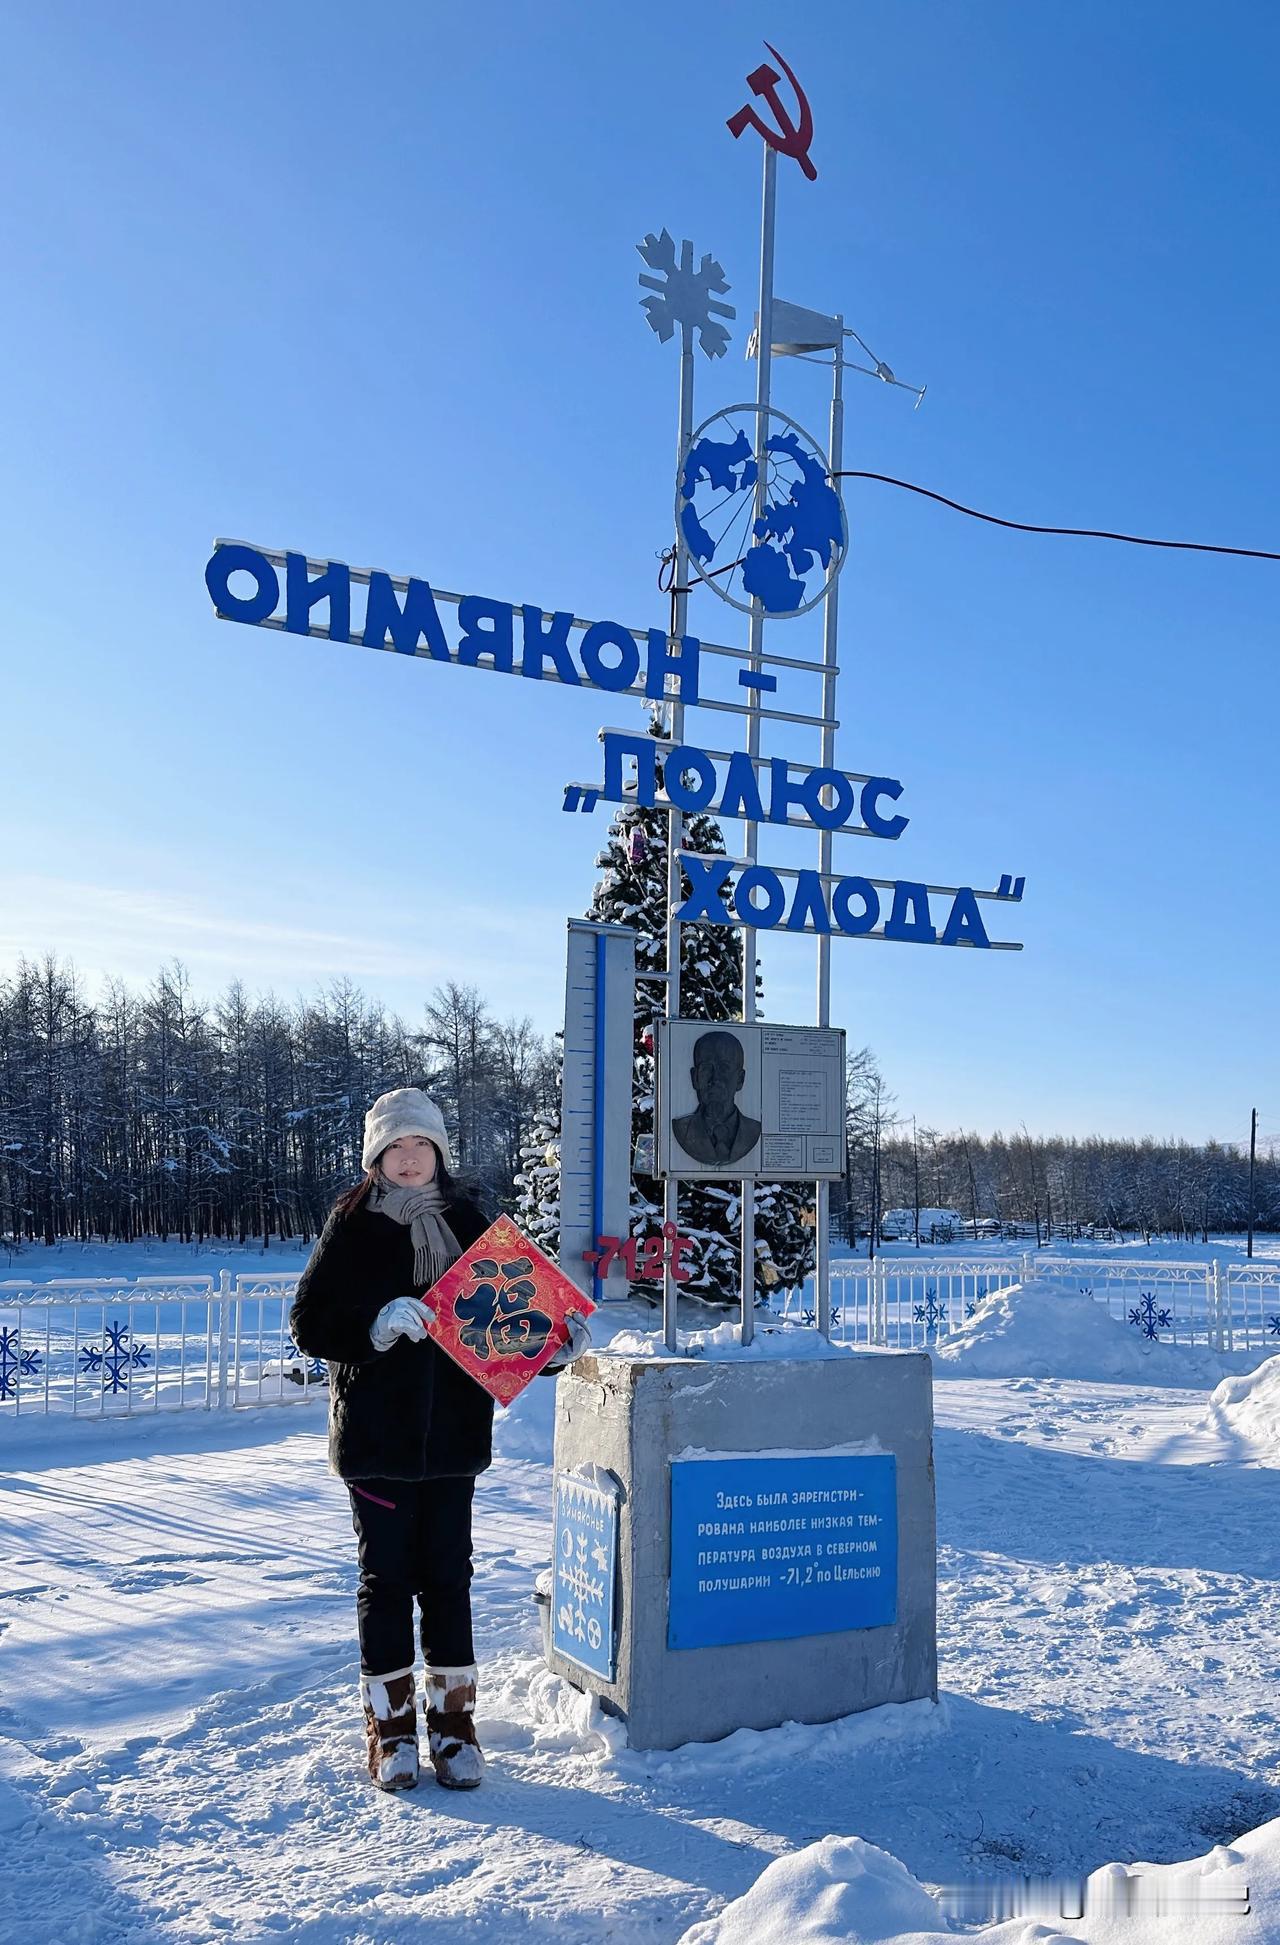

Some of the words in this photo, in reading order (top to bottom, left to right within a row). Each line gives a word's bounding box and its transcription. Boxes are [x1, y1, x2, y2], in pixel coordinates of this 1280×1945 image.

[454, 1256, 553, 1361] 福
[757, 1491, 788, 1506] БЫЛА
[791, 1489, 865, 1504] ЗАРЕГИСТРИ-
[698, 1522, 745, 1537] РОВАНА
[750, 1517, 807, 1534] НАИБОЛЕЕ
[811, 1514, 854, 1530] НИЗКАЯ
[858, 1514, 883, 1528] ТЕМ-
[698, 1548, 756, 1566] ПЕРАТУРА
[761, 1544, 812, 1561] ВОЗДУХА
[817, 1544, 823, 1556] В
[826, 1541, 878, 1556] СЕВЕРНОМ
[698, 1574, 771, 1593] ПОЛУШАРИИ
